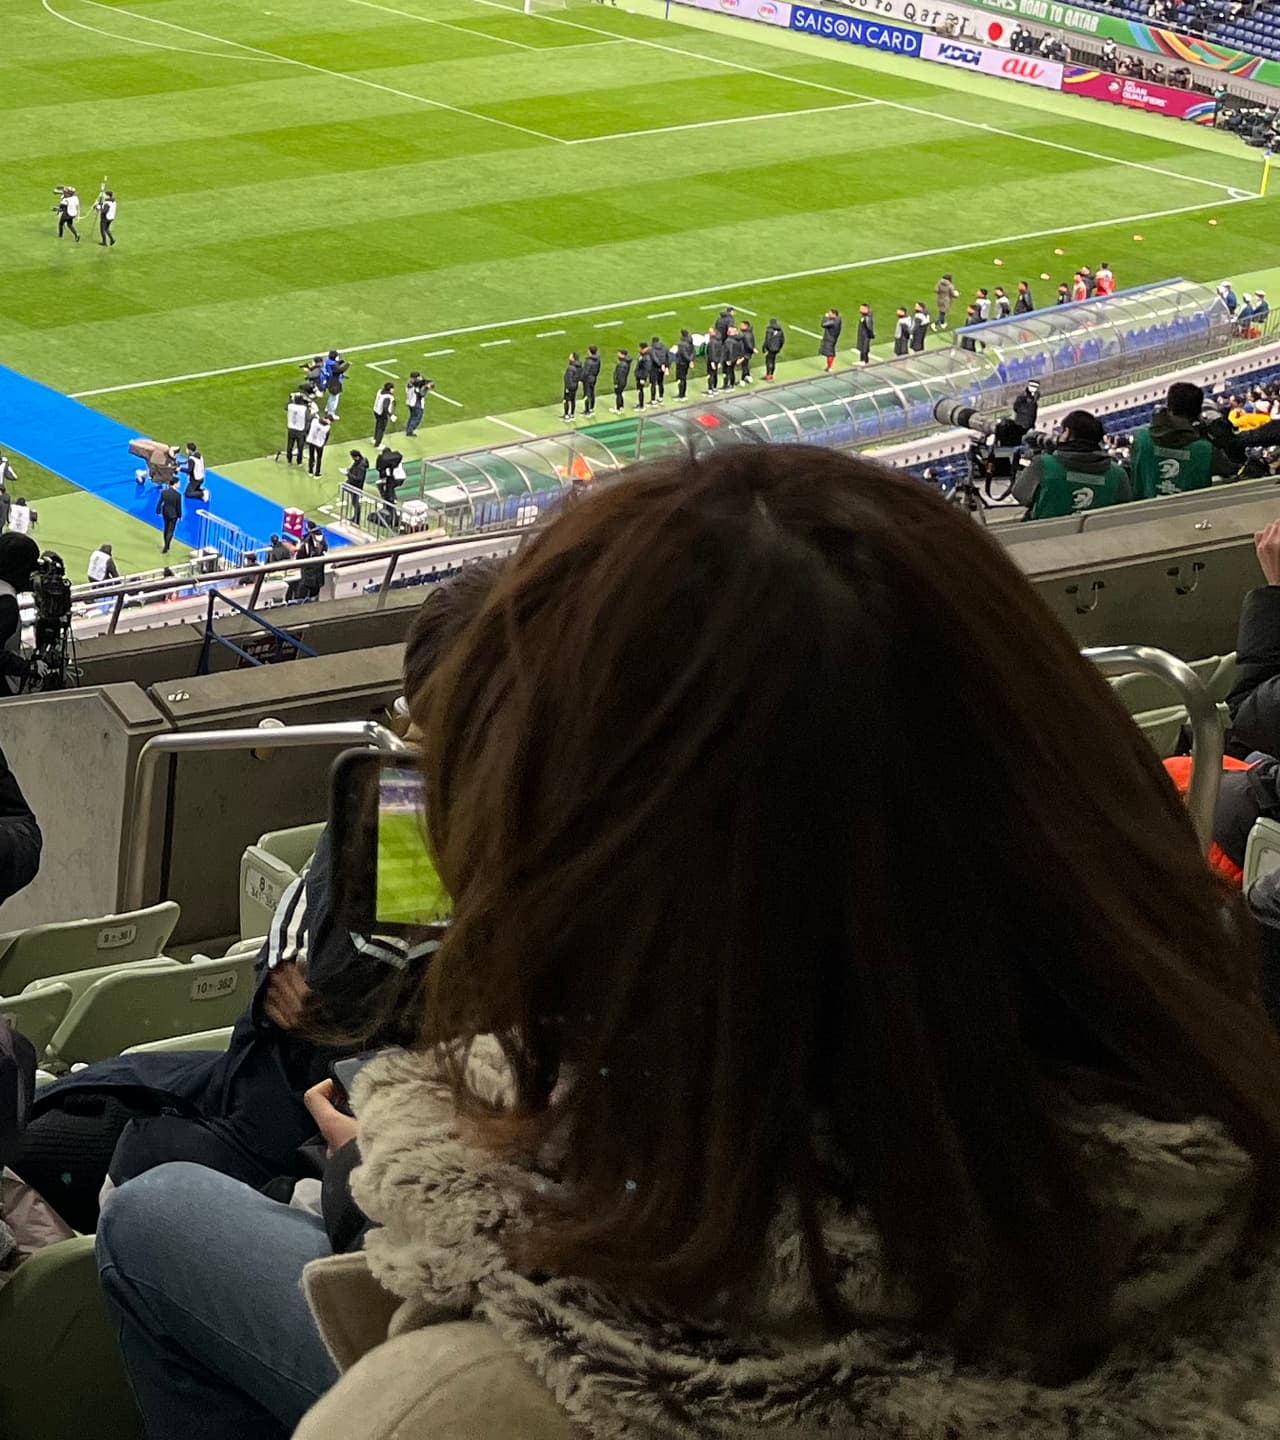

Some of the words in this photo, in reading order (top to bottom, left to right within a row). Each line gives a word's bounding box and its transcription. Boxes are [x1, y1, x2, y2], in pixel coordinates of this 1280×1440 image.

[1051, 4, 1063, 21] TO
[1065, 7, 1099, 32] QATAR
[795, 10, 856, 39] SAISON
[865, 25, 917, 52] CARD
[938, 43, 981, 66] KDDI
[1002, 57, 1045, 79] au
